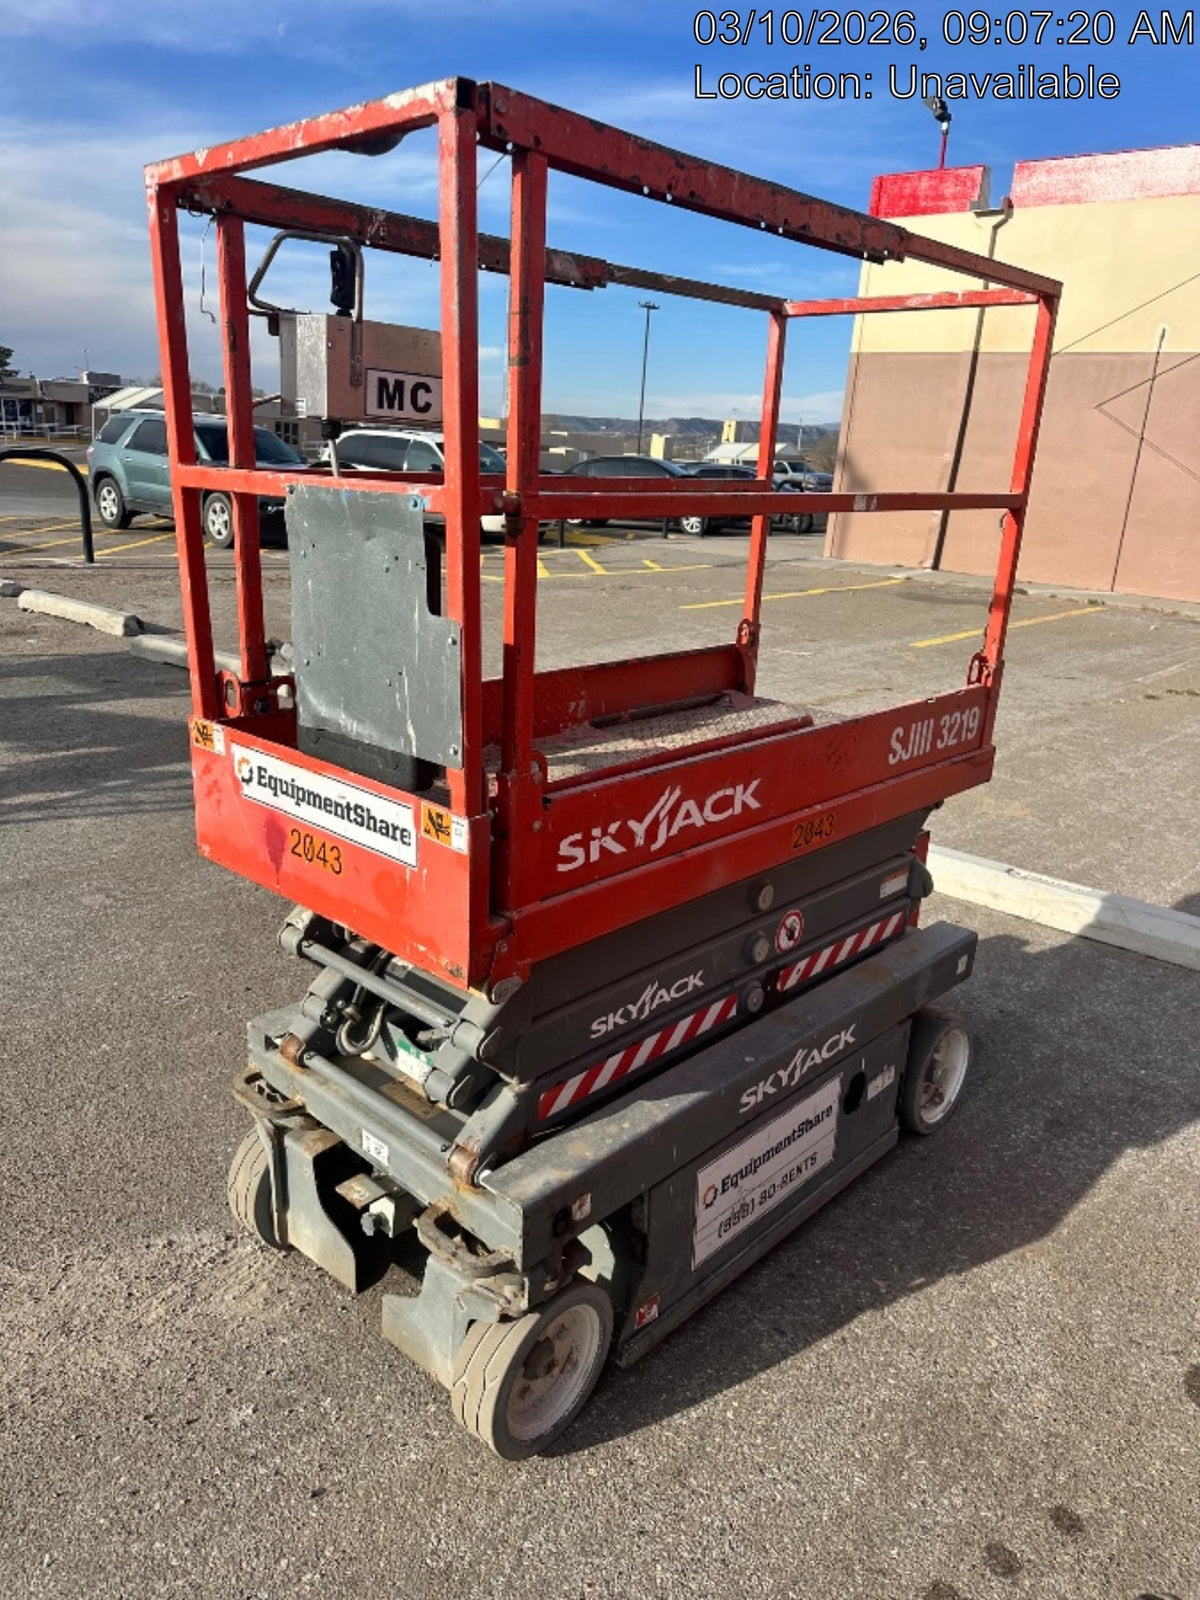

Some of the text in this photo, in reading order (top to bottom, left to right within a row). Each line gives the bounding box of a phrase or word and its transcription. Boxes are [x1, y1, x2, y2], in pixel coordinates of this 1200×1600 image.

[377, 376, 433, 414] MC
[936, 706, 981, 749] 3219
[256, 765, 412, 848] EquipmentShare
[290, 827, 343, 876] 2043
[792, 812, 835, 850] 2043
[720, 1104, 833, 1196] EquipmentShare
